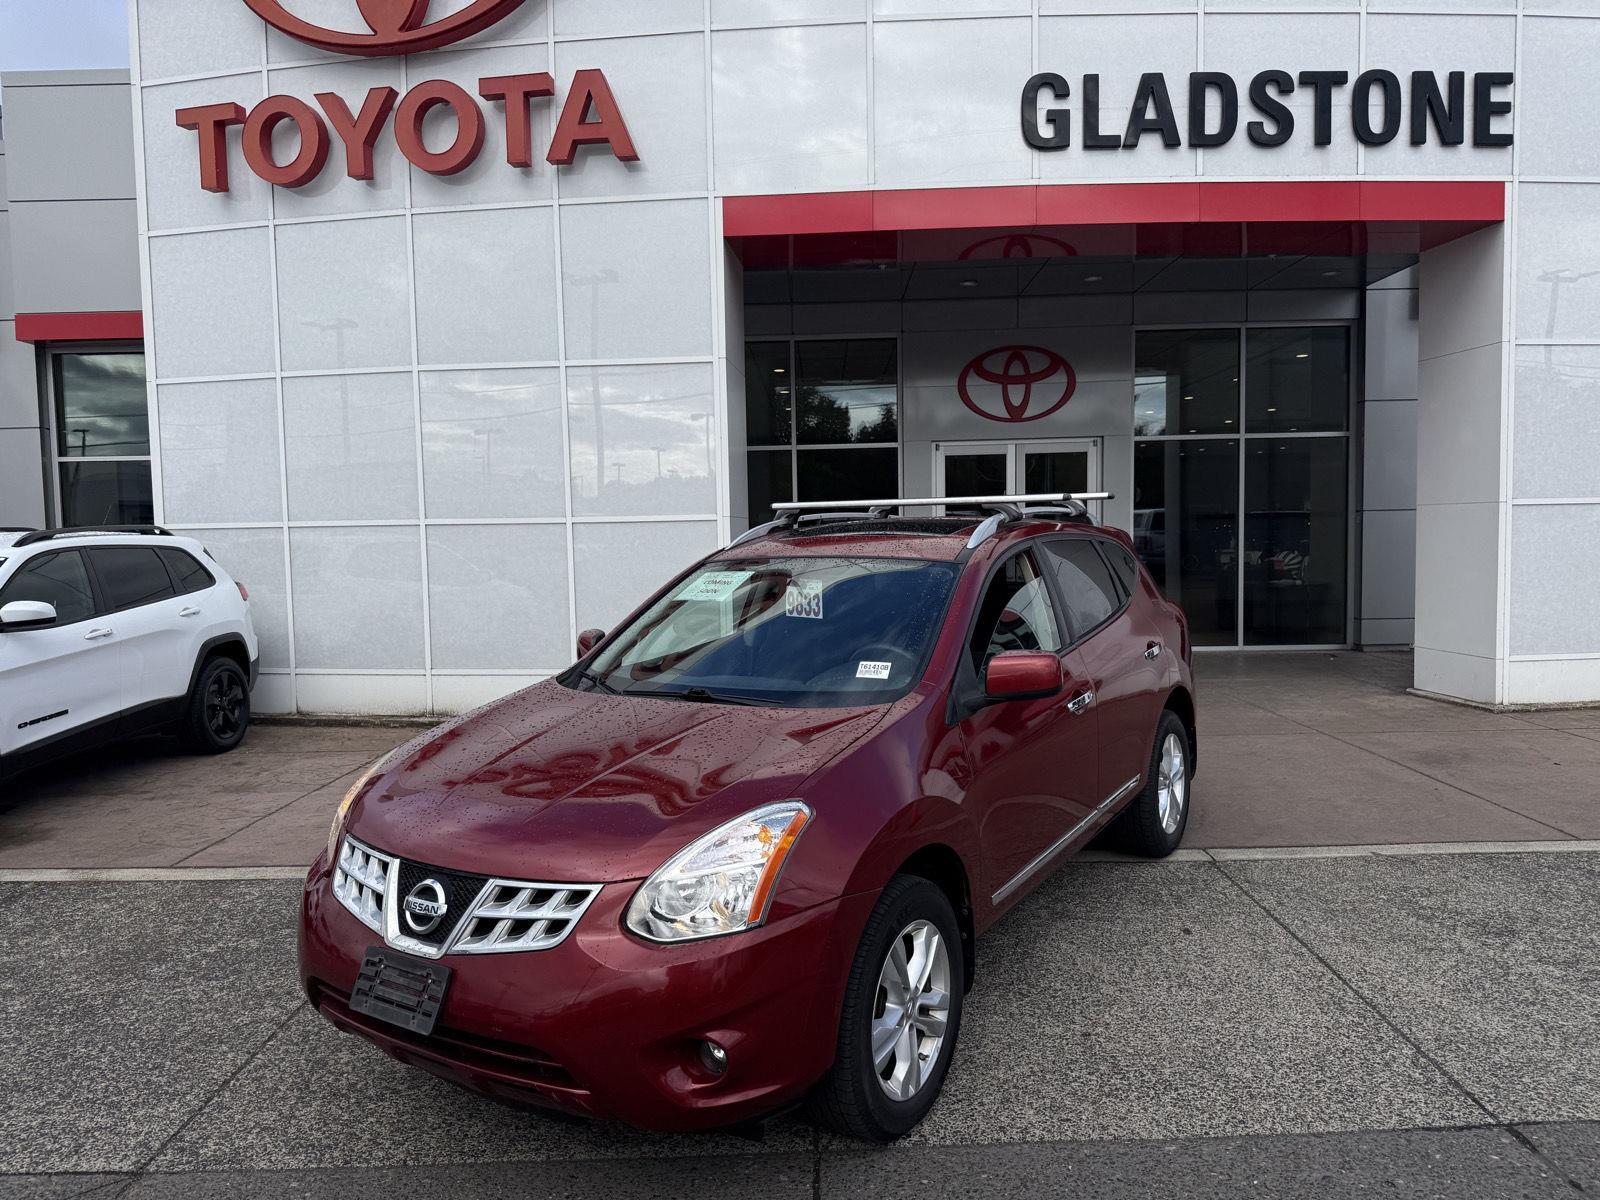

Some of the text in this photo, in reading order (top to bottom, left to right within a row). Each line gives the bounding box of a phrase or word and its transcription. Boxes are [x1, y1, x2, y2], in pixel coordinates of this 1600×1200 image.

[176, 69, 640, 193] TOYOTA
[1021, 69, 1514, 149] GLADSTONE
[407, 901, 439, 914] NISSAN
